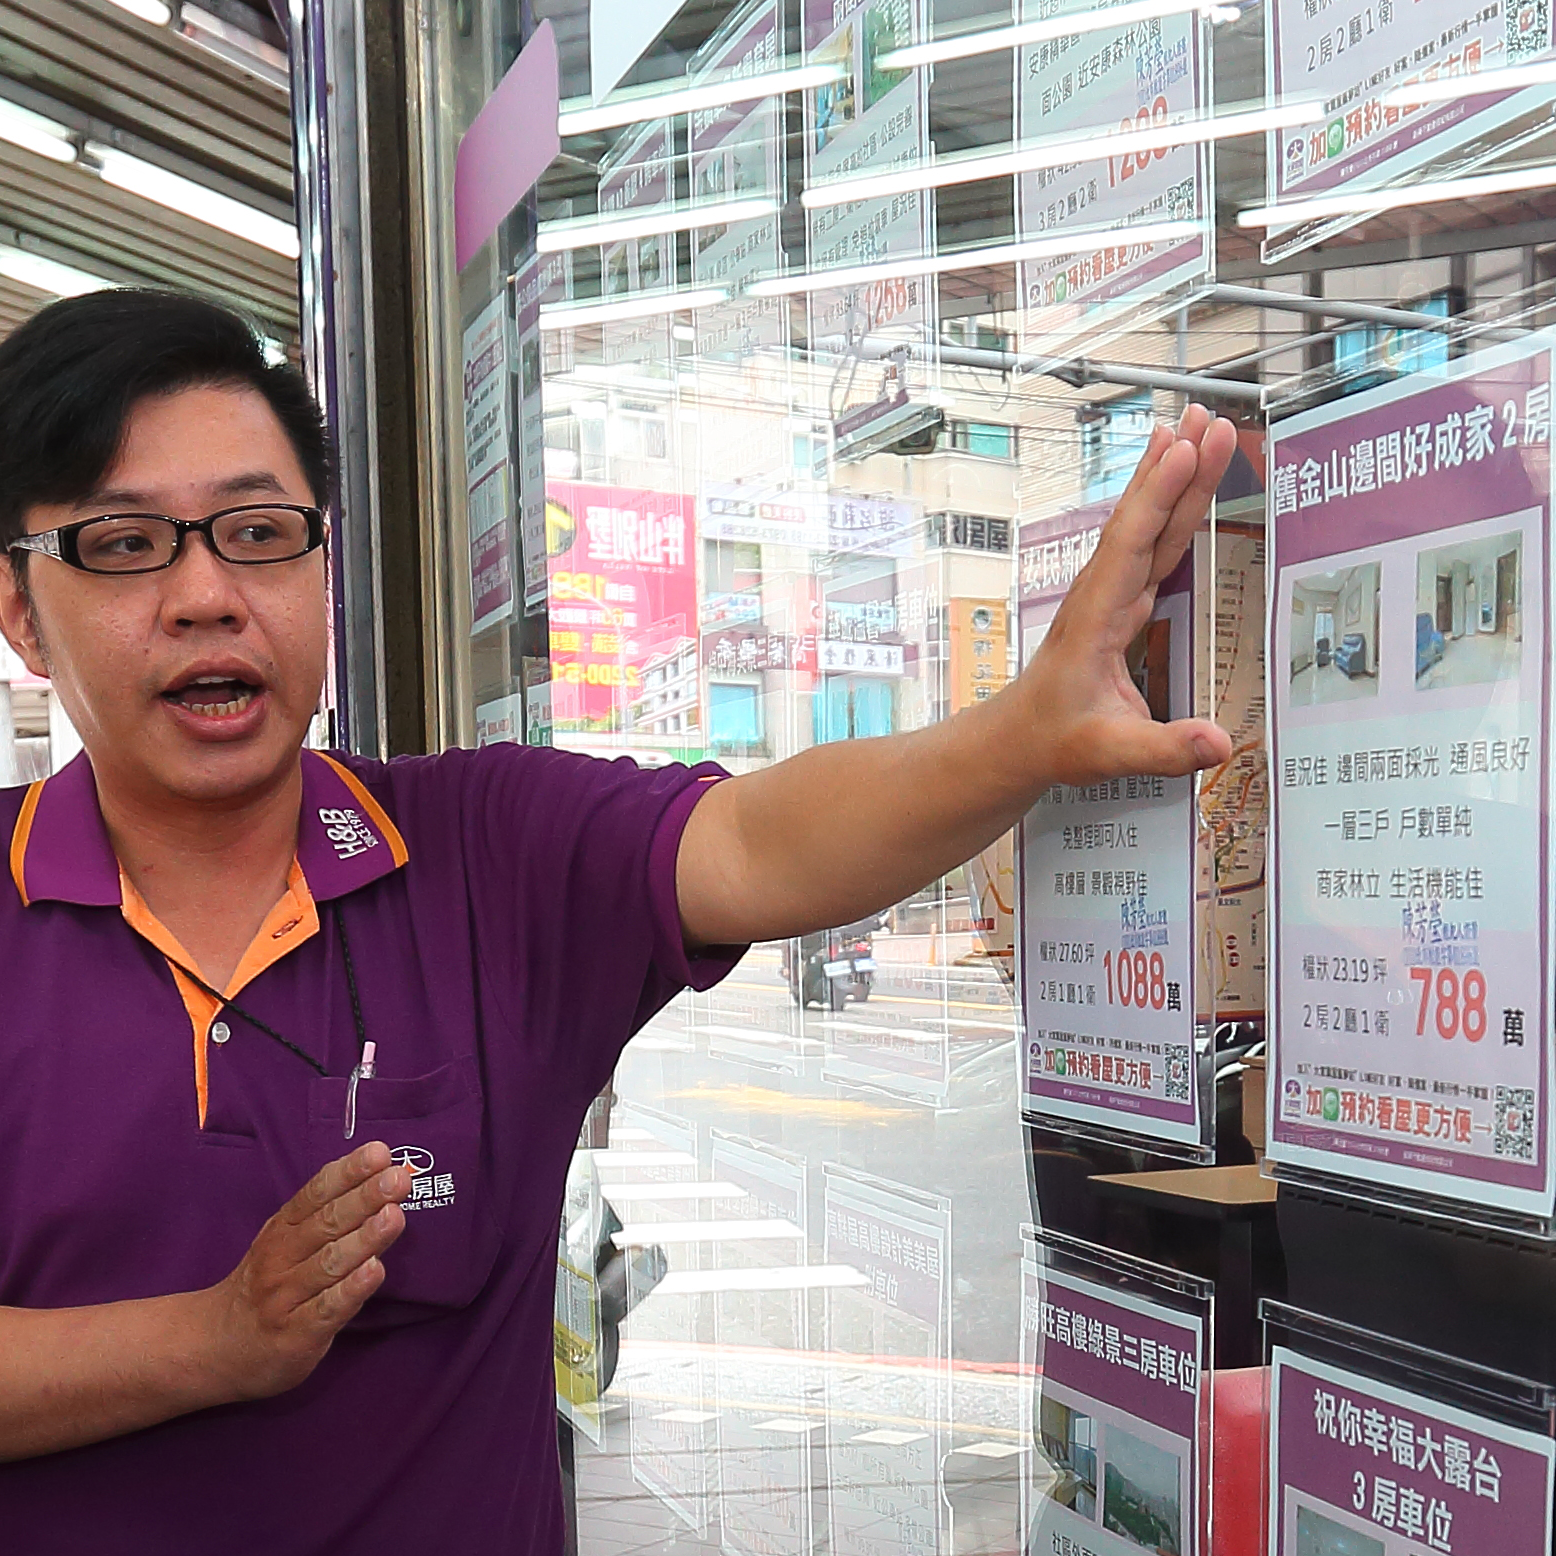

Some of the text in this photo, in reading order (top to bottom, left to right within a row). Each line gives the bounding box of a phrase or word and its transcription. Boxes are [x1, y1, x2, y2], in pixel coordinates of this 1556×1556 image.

[1309, 128, 1326, 166] 加
[1022, 526, 1101, 594] 安民新
[1283, 737, 1531, 788] 屋況佳 邊間兩面採光 通風良好
[318, 807, 367, 860] H&B
[1063, 822, 1138, 850] 免整理即可入住
[1324, 805, 1473, 842] 一層三戶 戶數單純
[1316, 868, 1484, 901] 商家林立 生活機能佳
[1103, 949, 1181, 1012] 1088 萬
[1410, 966, 1526, 1047] 788 萬
[407, 1172, 456, 1200] 房屋
[1314, 1388, 1503, 1504] 祝你幸福大露台
